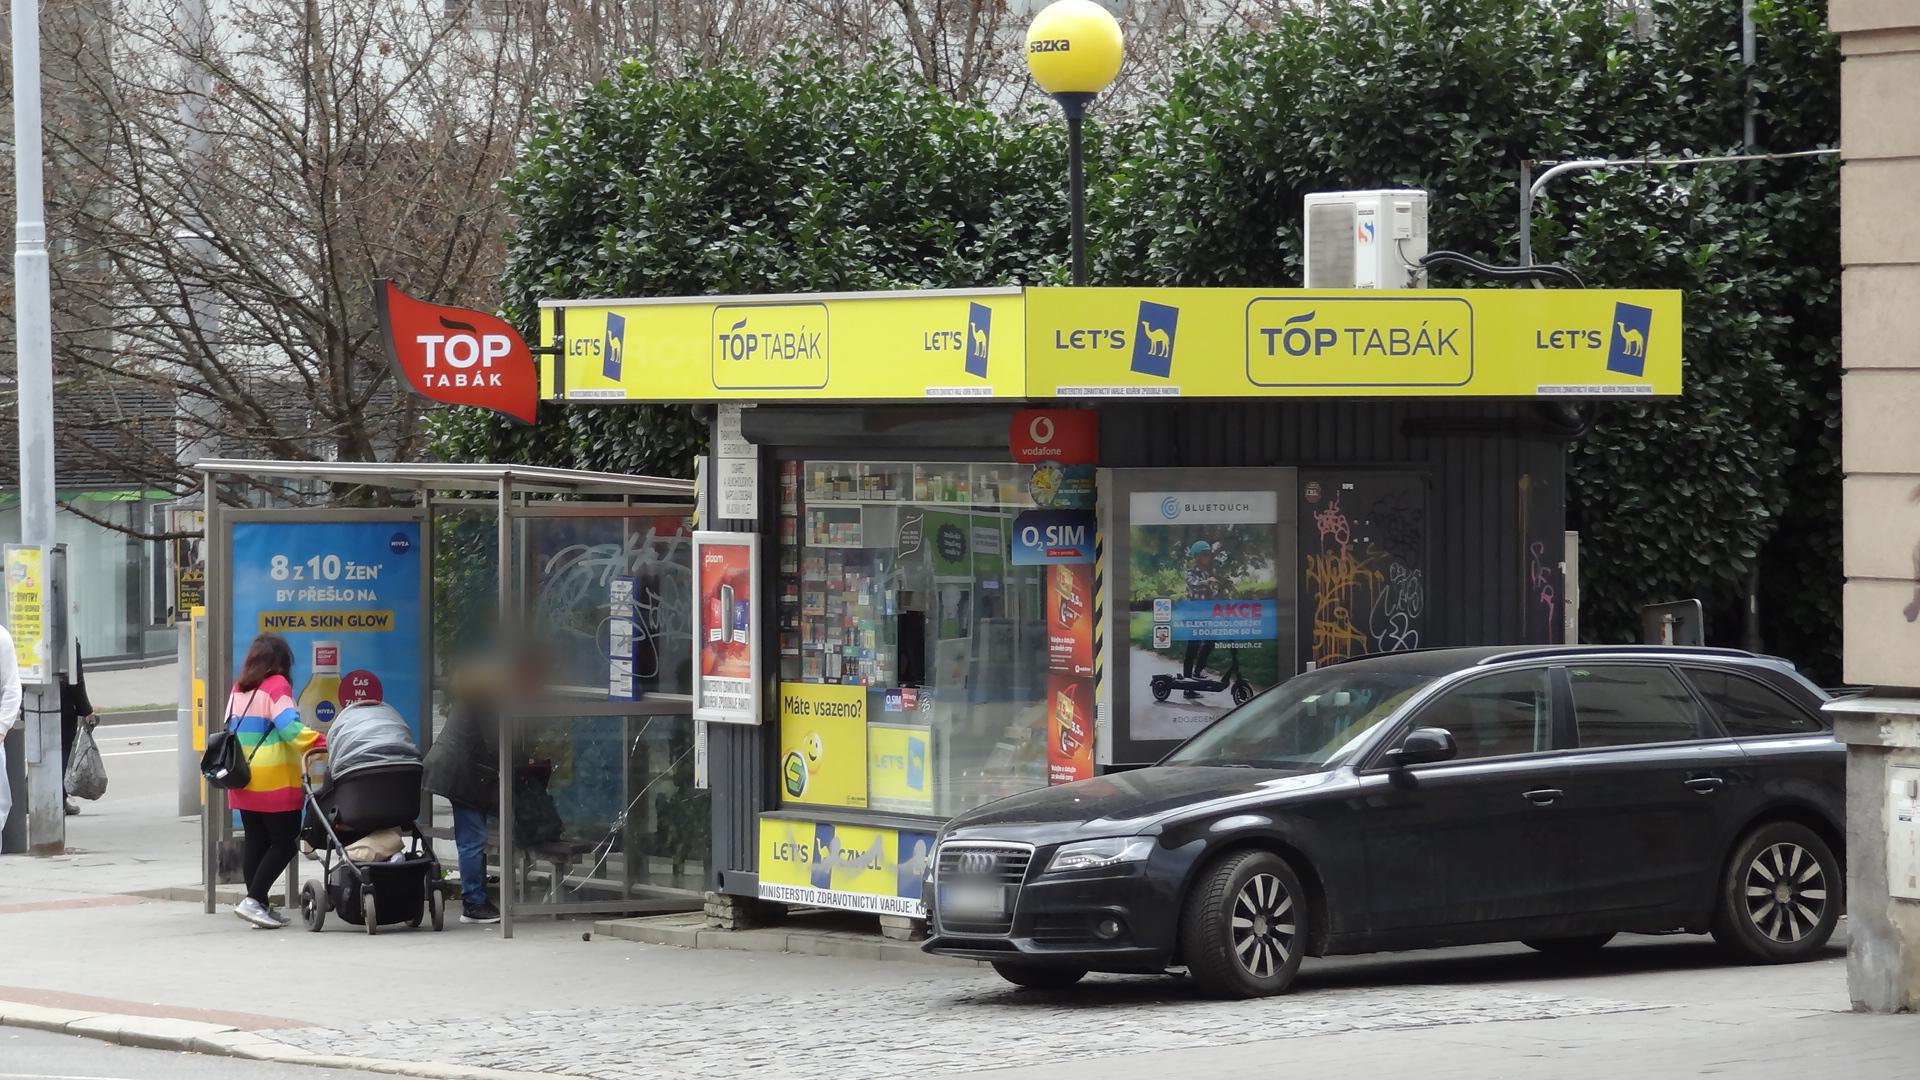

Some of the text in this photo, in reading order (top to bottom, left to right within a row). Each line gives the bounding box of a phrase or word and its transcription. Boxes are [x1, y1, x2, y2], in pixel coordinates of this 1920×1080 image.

[568, 337, 600, 357] LET'S
[719, 325, 822, 361] TOP TABÁK
[924, 330, 962, 351] LET'S
[1055, 329, 1126, 350] LET'S
[1260, 320, 1459, 357] TOP TABÁK
[1536, 329, 1602, 349] LET'S
[416, 333, 511, 369] TOP
[423, 370, 502, 387] TABÁK
[1022, 446, 1062, 456] vodafone
[1184, 503, 1250, 512] BLUETOUCH
[1045, 525, 1085, 547] SIM
[270, 554, 289, 581] 8
[307, 554, 341, 581] 10
[276, 586, 378, 602] BY PŘEŠLO NA
[1212, 602, 1263, 618] AKCE
[264, 615, 388, 627] NIVEA SKIN GLOW
[352, 677, 369, 686] ČAS
[354, 689, 367, 697] NA
[784, 696, 863, 719] Máte vsazeno?
[759, 884, 815, 903] MINISTERSTVO
[817, 891, 878, 910] ZDRAVOTNICTVÍ
[880, 898, 913, 914] VARUJE:
